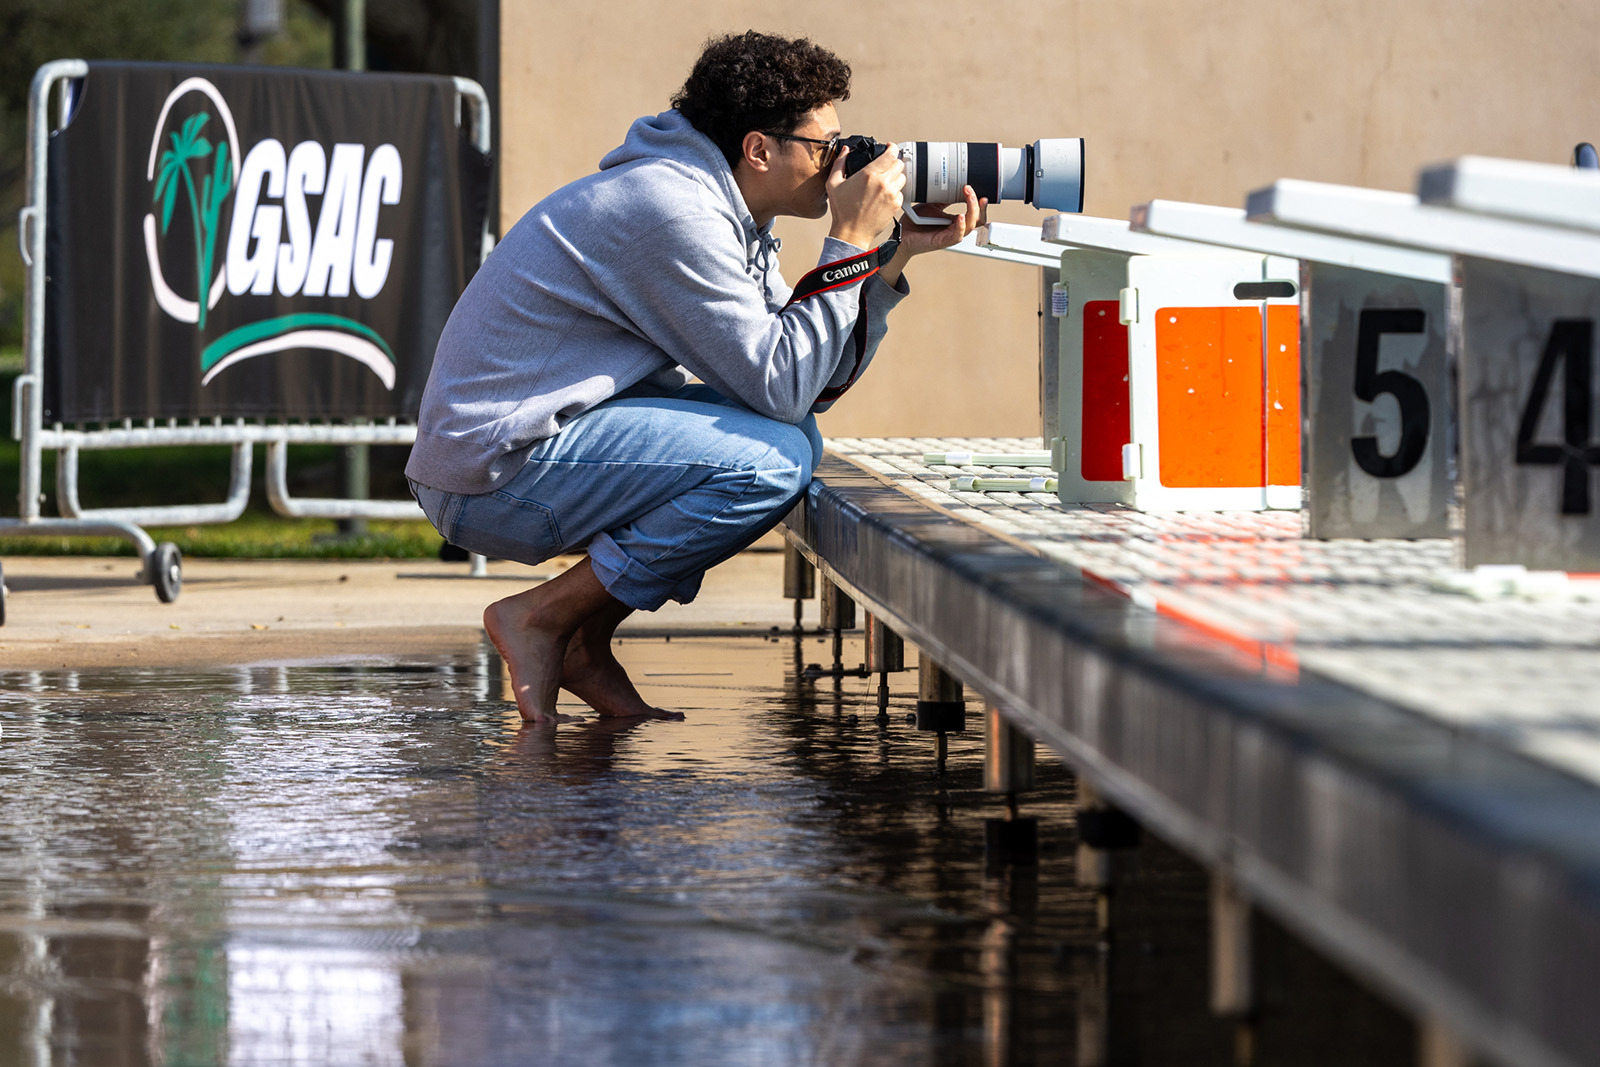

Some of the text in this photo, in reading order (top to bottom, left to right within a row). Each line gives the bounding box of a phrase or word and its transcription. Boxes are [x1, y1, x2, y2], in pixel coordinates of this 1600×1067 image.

[226, 138, 402, 299] GSAC
[822, 260, 869, 282] Canon
[1351, 309, 1431, 478] 5
[1516, 318, 1600, 515] 4
